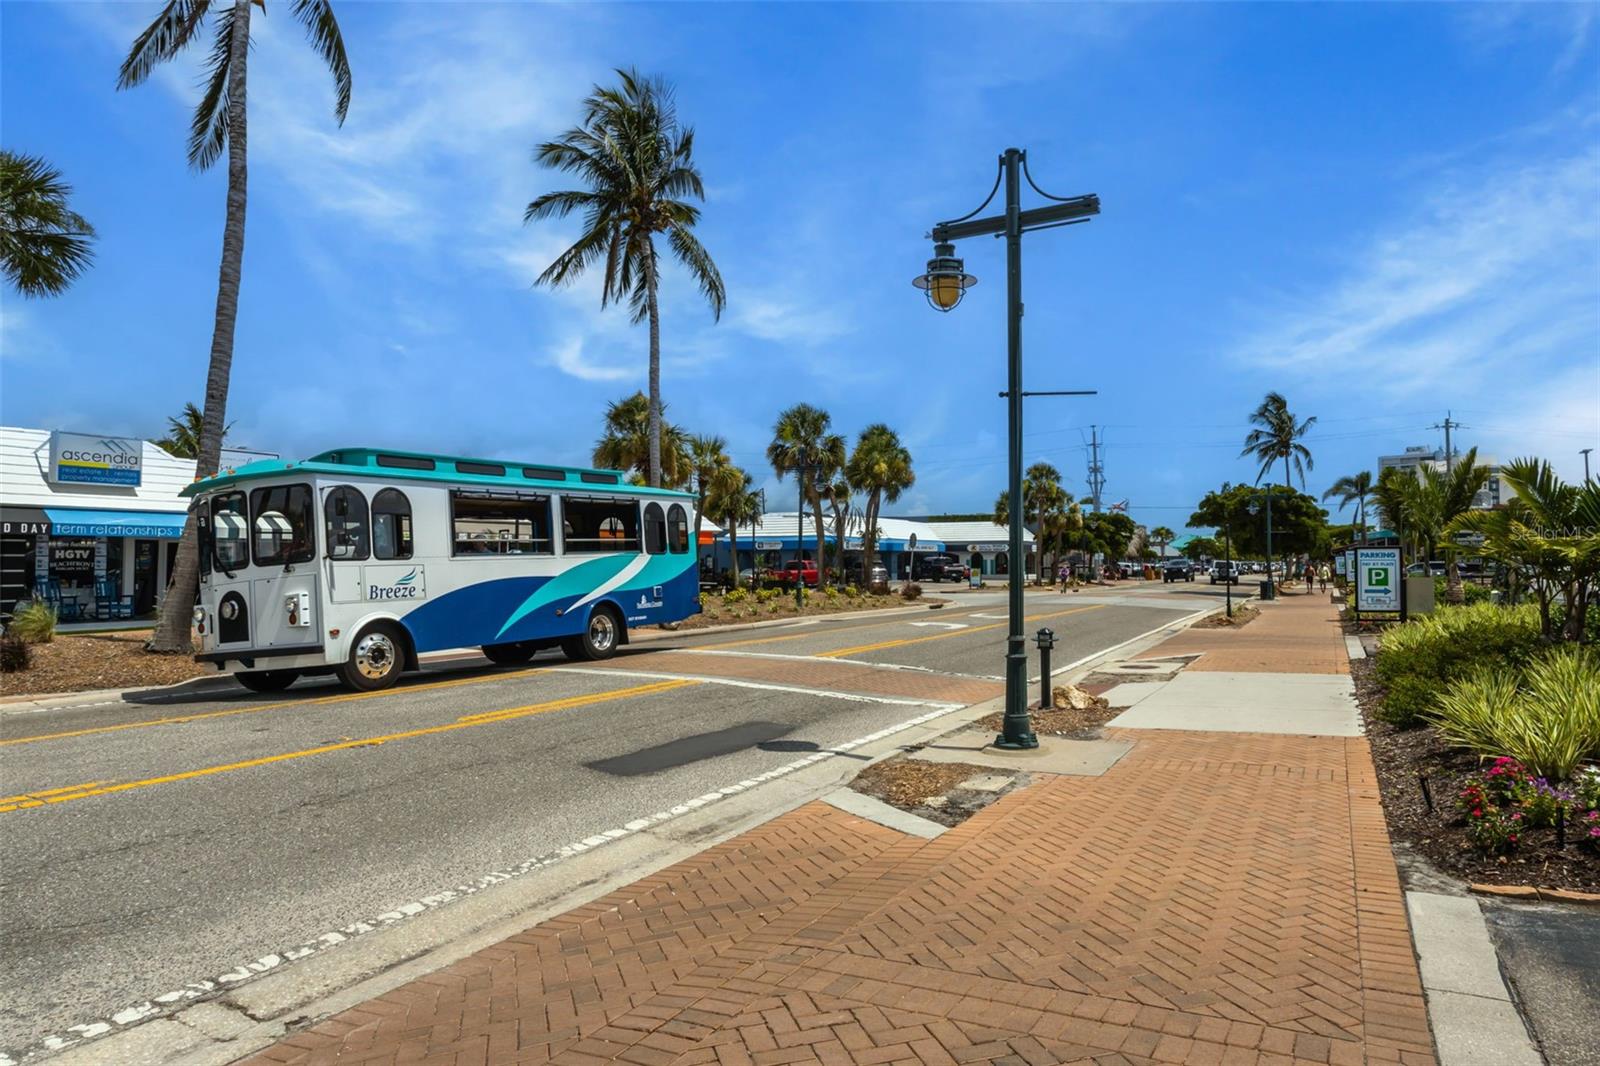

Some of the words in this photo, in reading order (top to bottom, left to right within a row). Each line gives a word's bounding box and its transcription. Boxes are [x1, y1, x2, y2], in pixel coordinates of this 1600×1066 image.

[61, 450, 138, 465] ascendia
[20, 522, 48, 534] DAY
[55, 524, 87, 535] term
[90, 525, 173, 537] relationships
[55, 550, 90, 559] HGTV
[1371, 569, 1385, 585] P
[369, 584, 416, 600] Breeze
